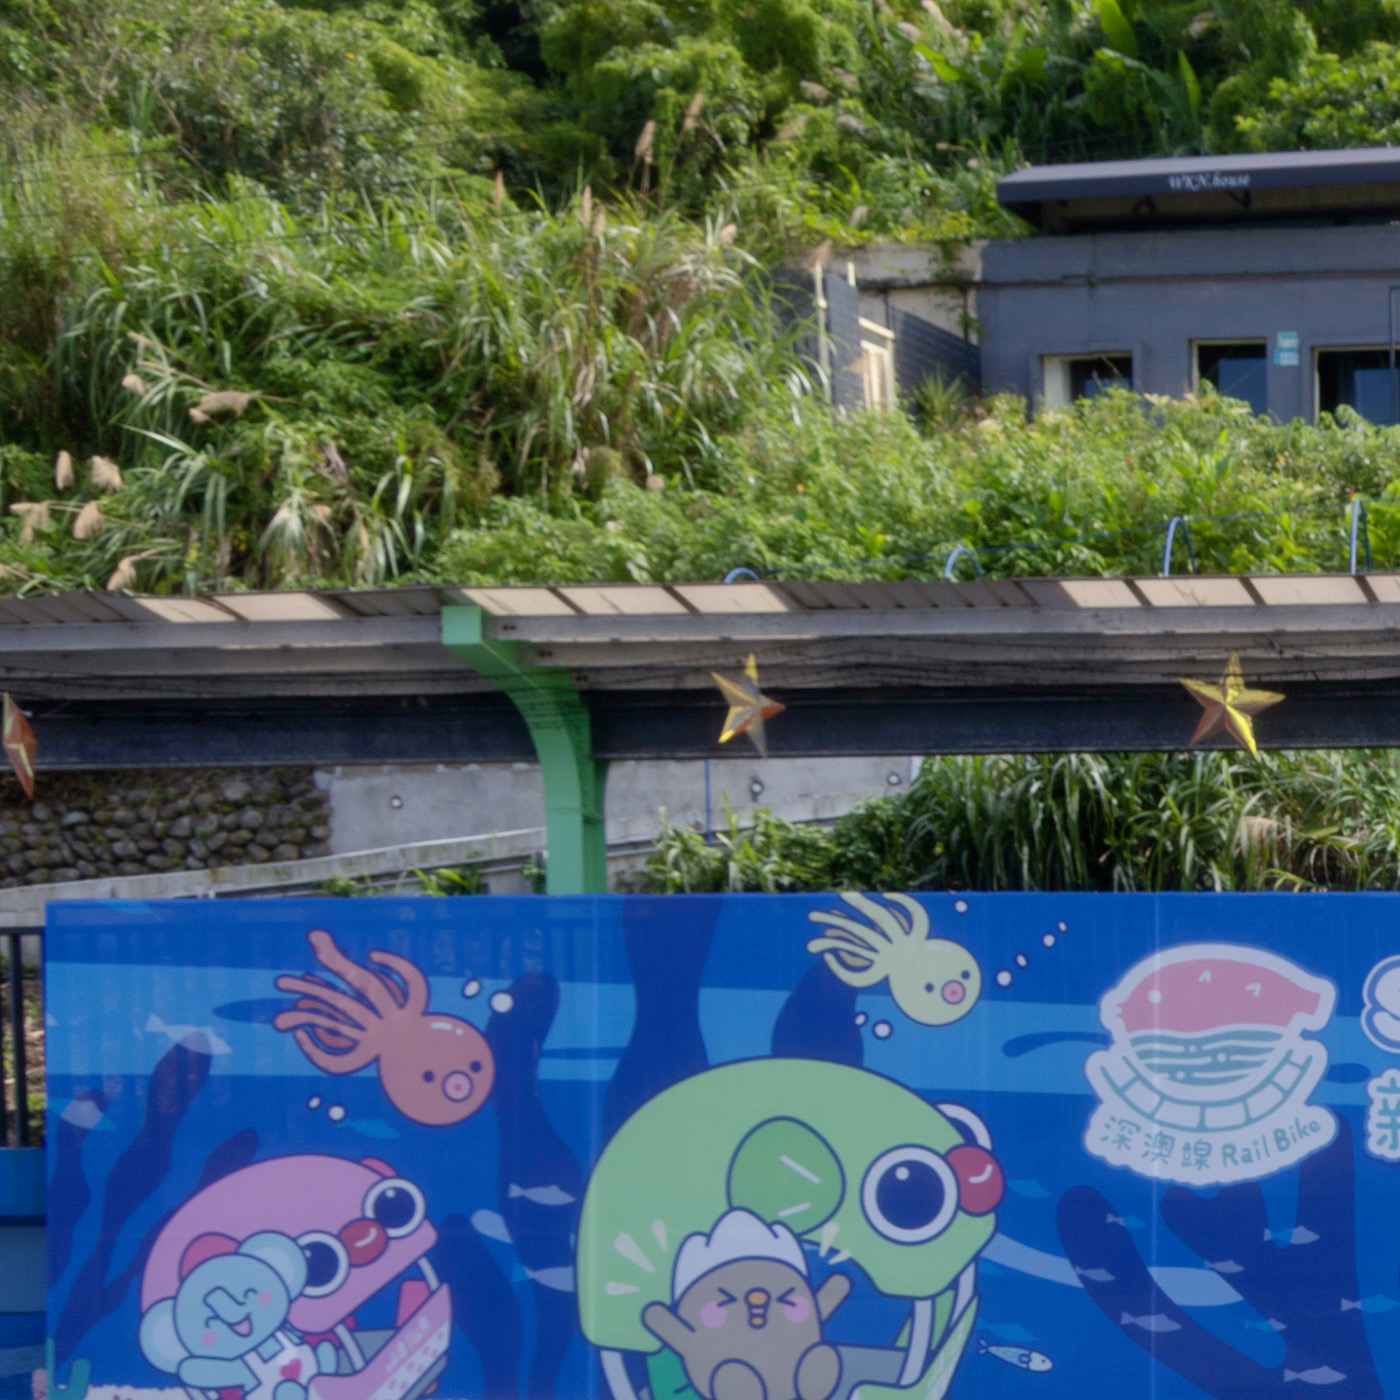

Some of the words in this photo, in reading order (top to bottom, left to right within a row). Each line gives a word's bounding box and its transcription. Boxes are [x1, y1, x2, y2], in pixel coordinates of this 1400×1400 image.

[1100, 1114, 1212, 1170] 深澳線
[1221, 1137, 1272, 1169] Rail
[1274, 1116, 1321, 1154] Bike
